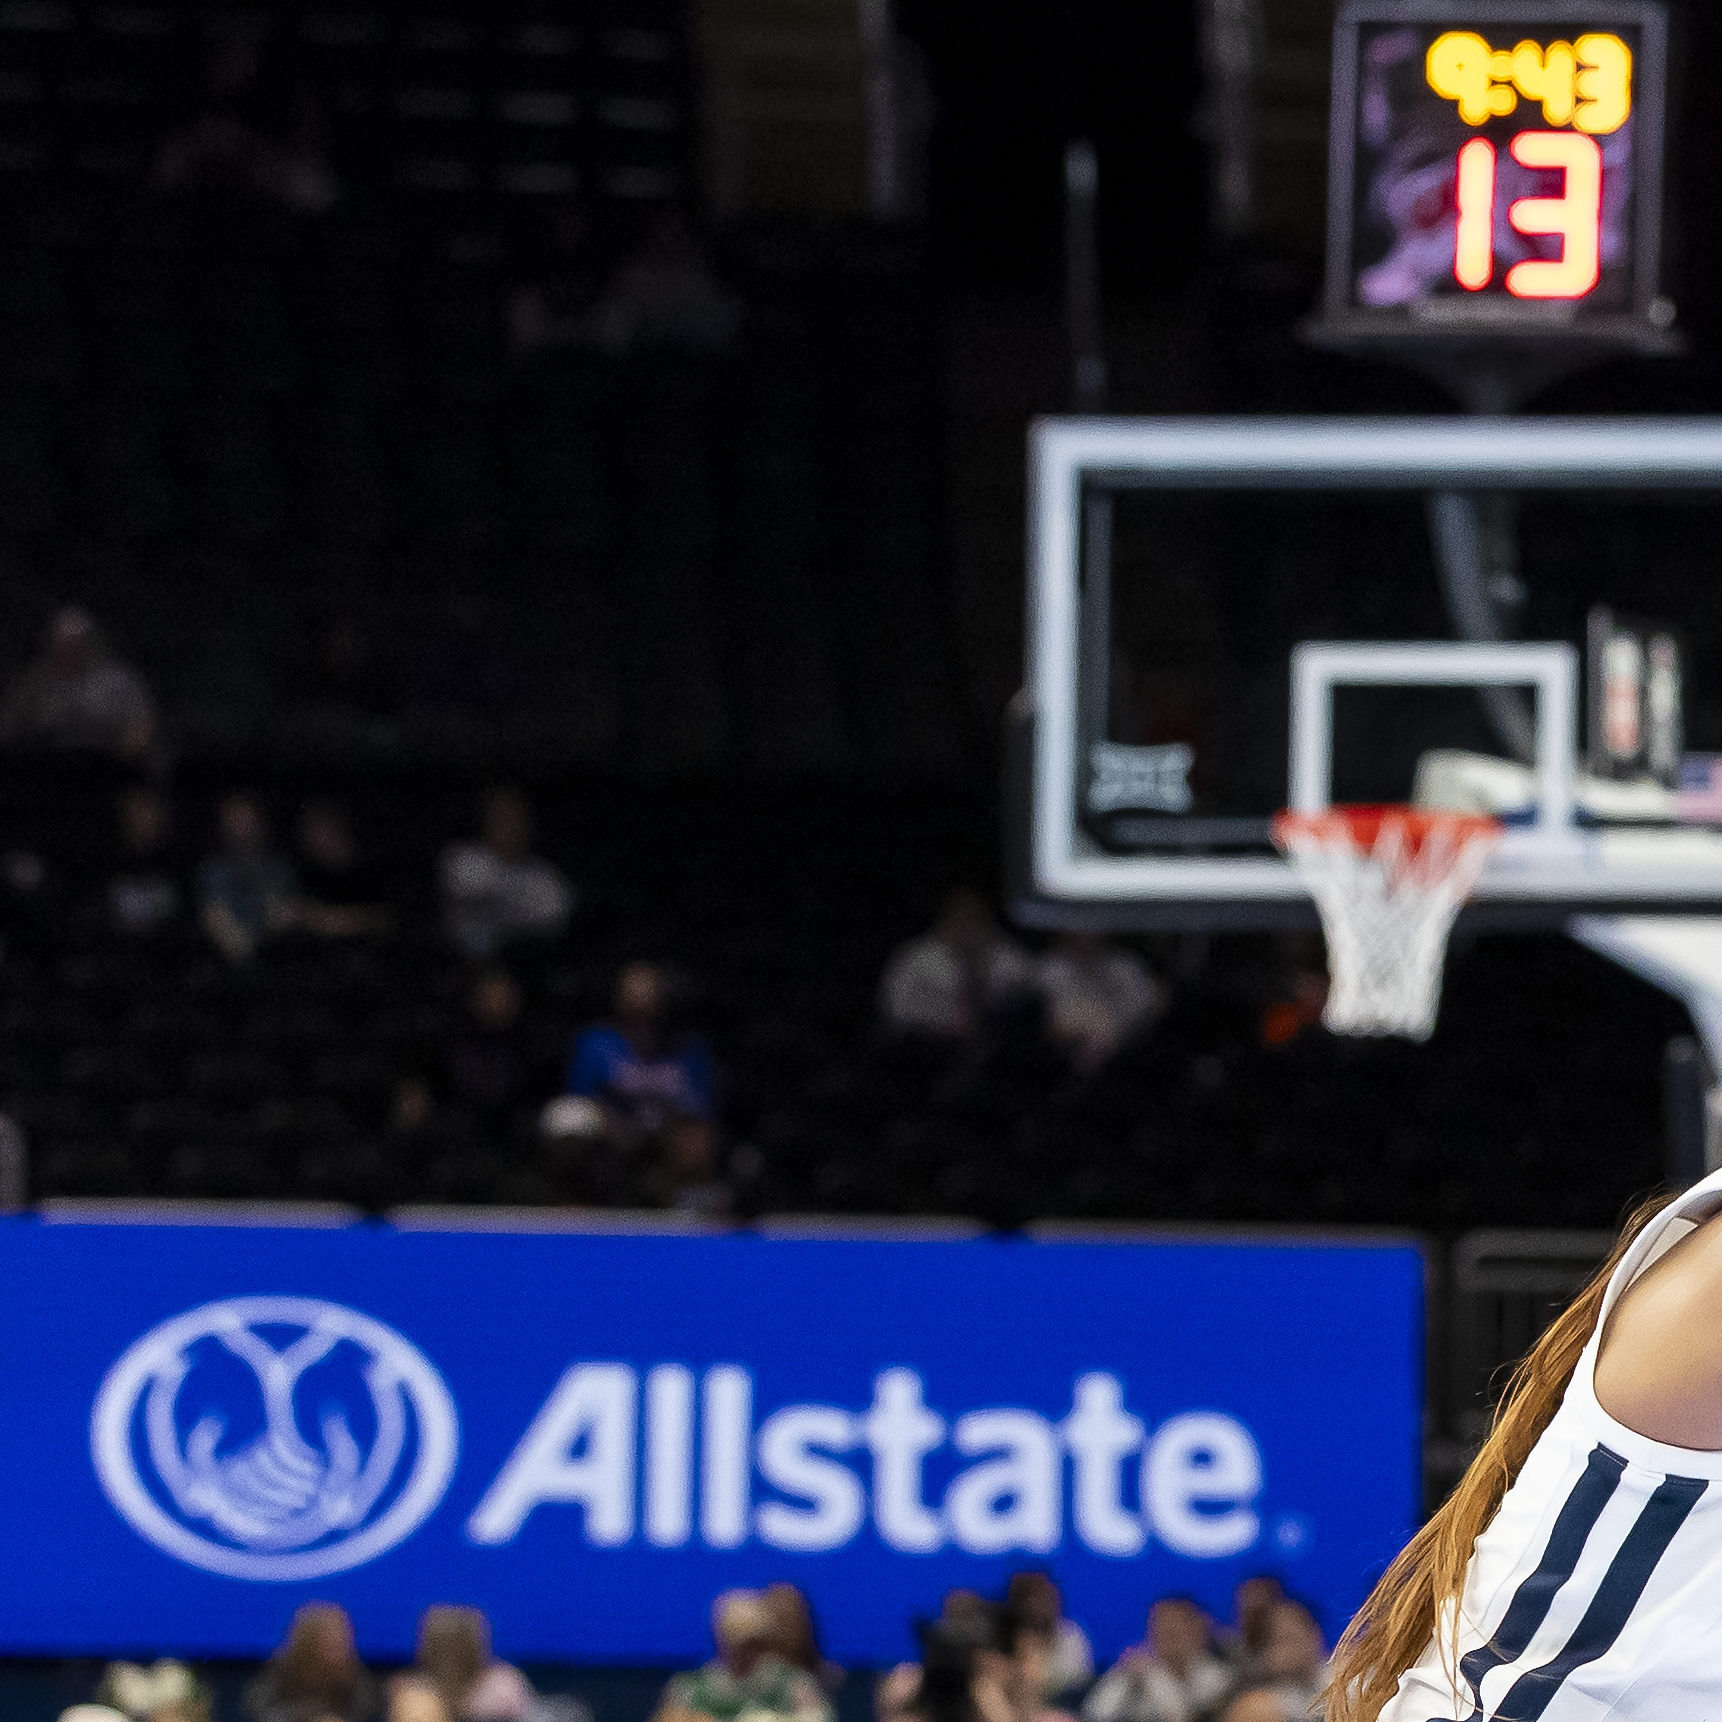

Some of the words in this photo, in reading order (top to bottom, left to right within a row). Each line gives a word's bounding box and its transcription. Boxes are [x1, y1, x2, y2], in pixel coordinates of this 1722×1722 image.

[1426, 31, 1632, 135] 9:43
[1454, 130, 1603, 299] 13
[470, 1361, 1262, 1557] Allstate
